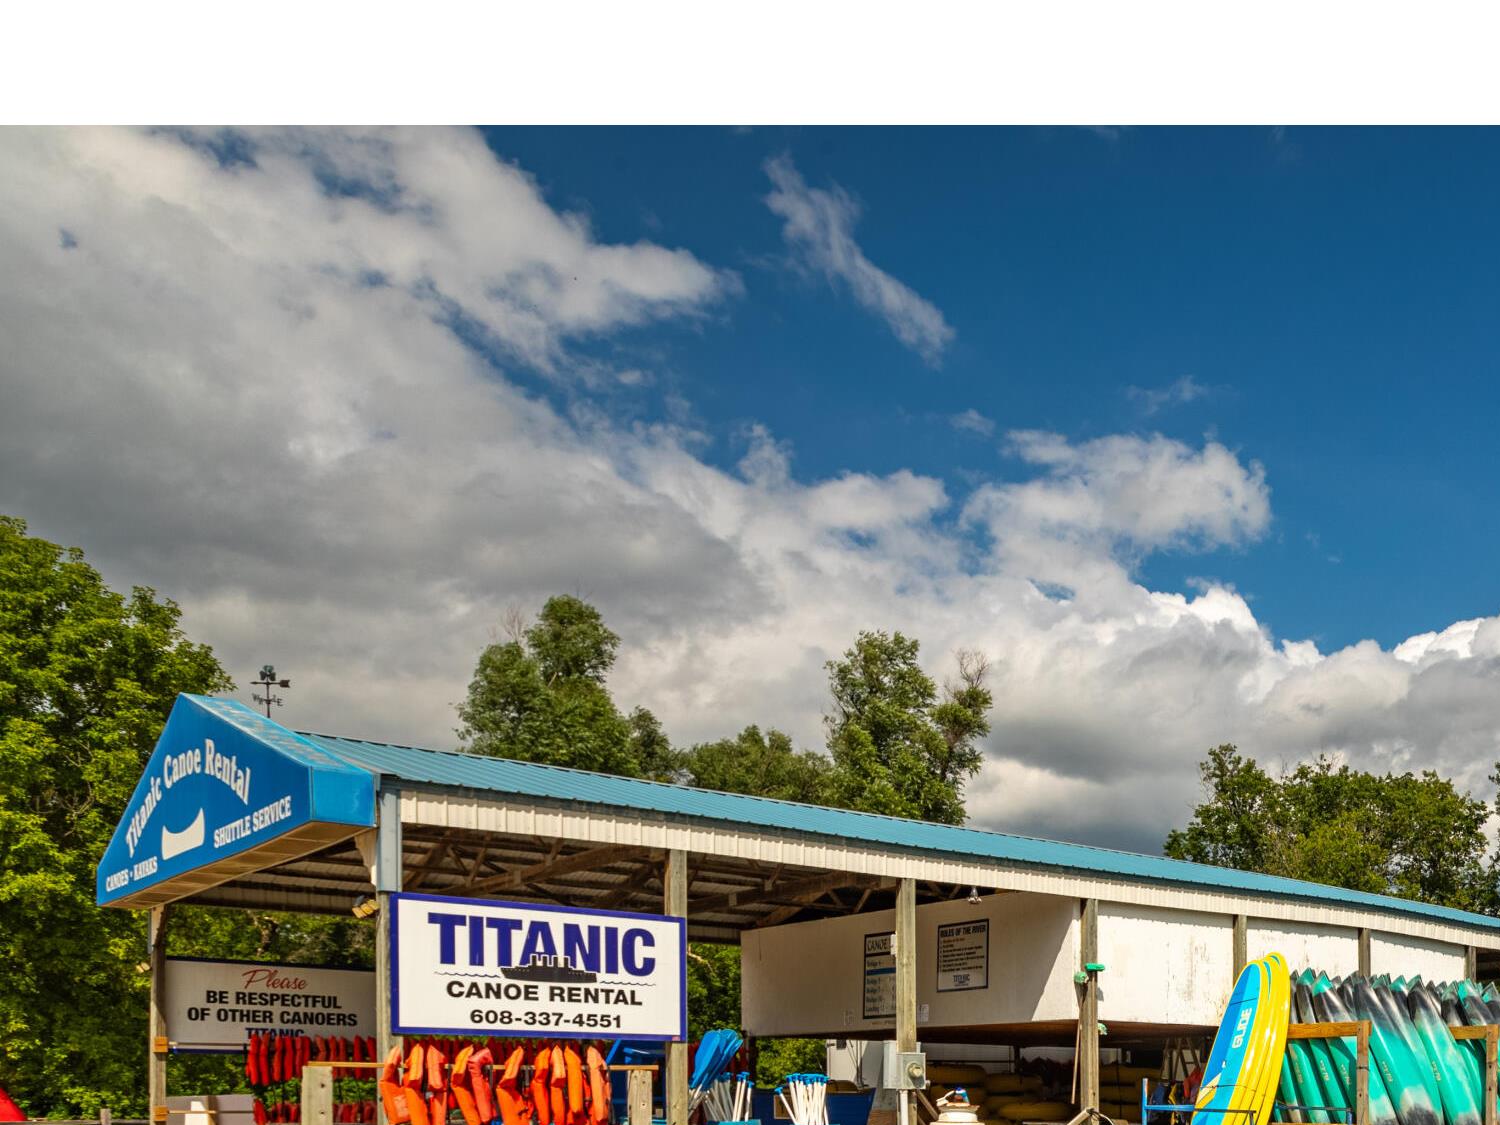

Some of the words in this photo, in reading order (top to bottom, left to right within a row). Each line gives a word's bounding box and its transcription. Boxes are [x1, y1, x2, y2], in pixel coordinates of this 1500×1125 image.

[125, 776, 162, 859] Titanic
[163, 748, 201, 789] Canoe
[204, 738, 251, 806] Rental
[213, 816, 252, 849] SHUTTLE
[252, 795, 292, 833] SERVICE
[105, 867, 129, 892] CANOES
[133, 856, 158, 881] KAYAKS
[428, 912, 656, 977] TITANIC
[242, 969, 308, 990] Please
[446, 981, 539, 1001] CANOE
[549, 986, 643, 1006] RENTAL
[206, 990, 229, 1004] BE
[235, 992, 342, 1009] RESPECTFUL
[187, 1007, 210, 1021] OF
[217, 1008, 274, 1024] OTHER
[280, 1011, 358, 1027] CANOERS
[469, 1009, 622, 1029] 608-337-4551
[1232, 1008, 1252, 1049] GLIDE
